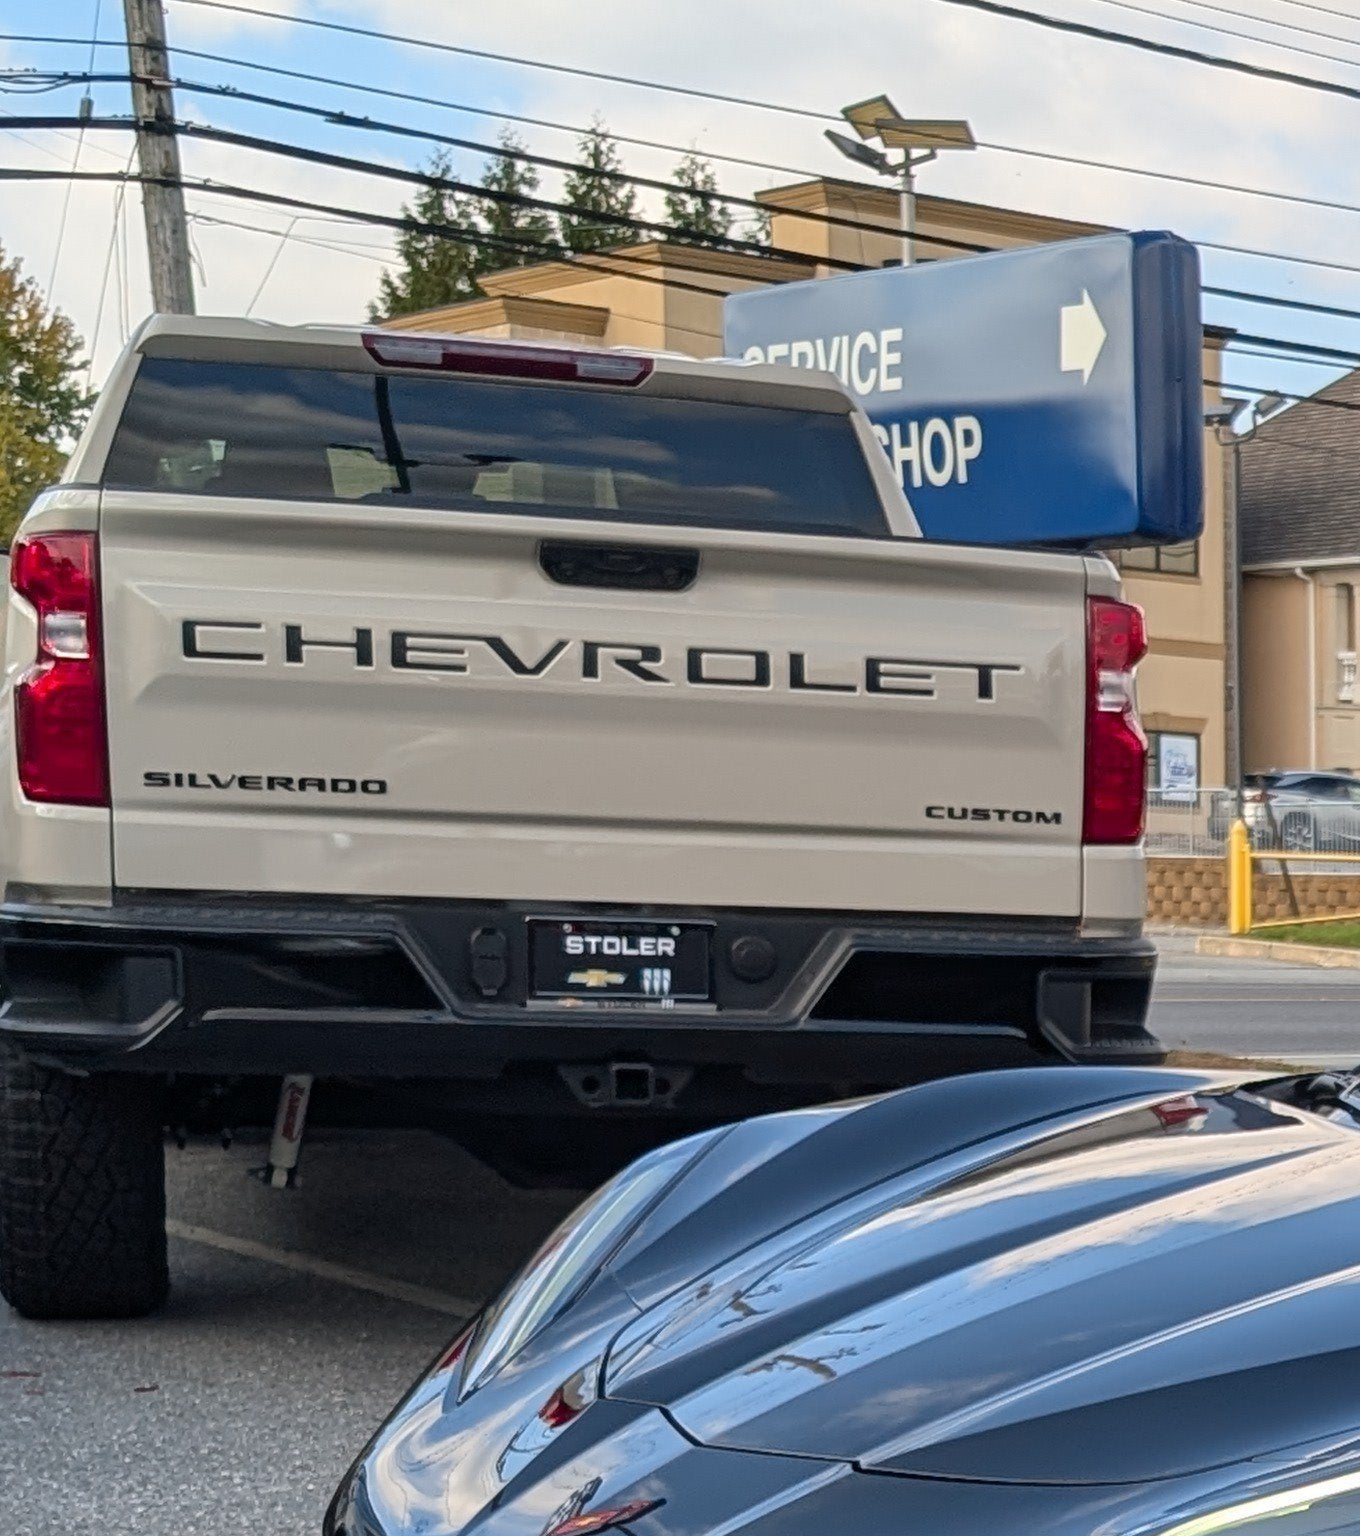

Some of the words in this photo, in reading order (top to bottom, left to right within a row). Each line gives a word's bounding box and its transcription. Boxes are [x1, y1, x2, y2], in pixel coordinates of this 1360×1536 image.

[181, 619, 1023, 701] CHEVROLET
[142, 771, 388, 794] SILVERADO
[924, 805, 1063, 824] CUSTOM
[565, 935, 676, 957] STOLER
